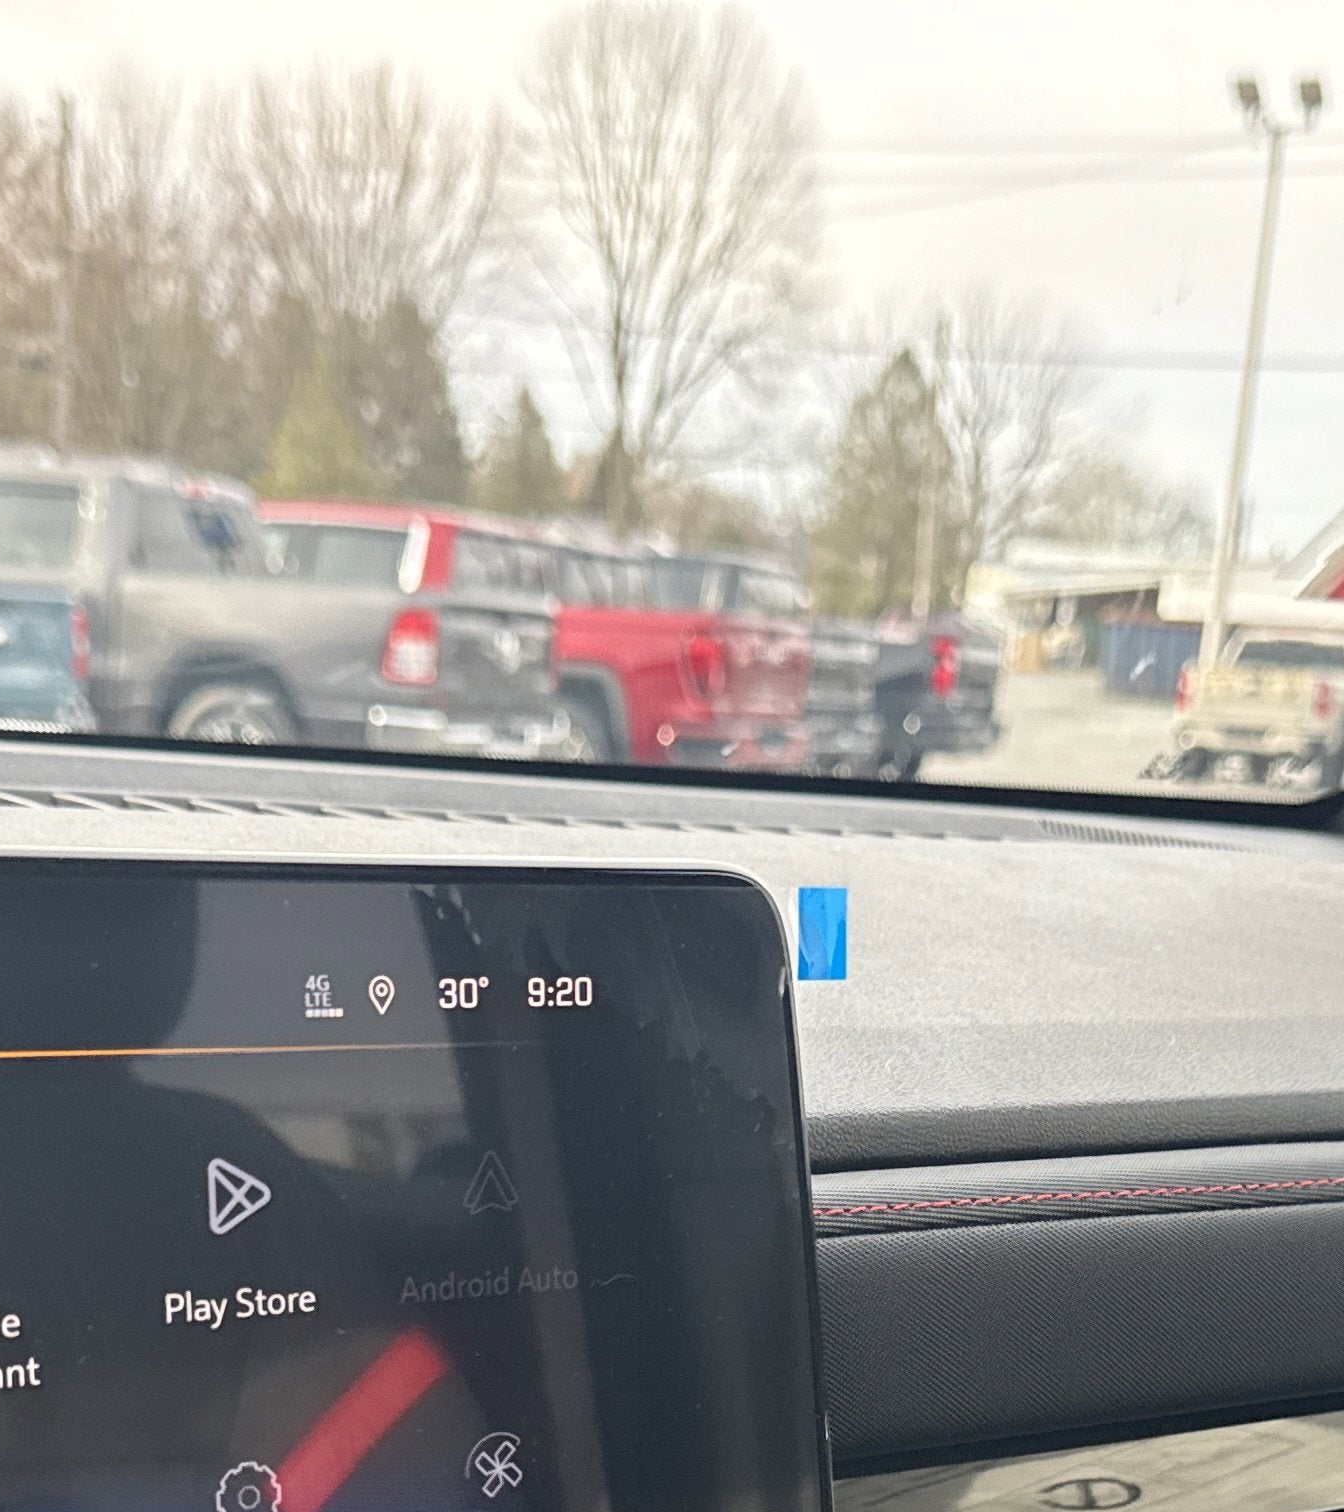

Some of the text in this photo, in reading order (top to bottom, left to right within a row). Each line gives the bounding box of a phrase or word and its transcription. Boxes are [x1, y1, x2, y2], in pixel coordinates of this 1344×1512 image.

[305, 974, 330, 991] 4G
[527, 976, 593, 1007] 9:20
[304, 991, 333, 1008] LTE
[400, 1265, 578, 1303] Android Auto
[163, 1286, 317, 1330] Play Store
